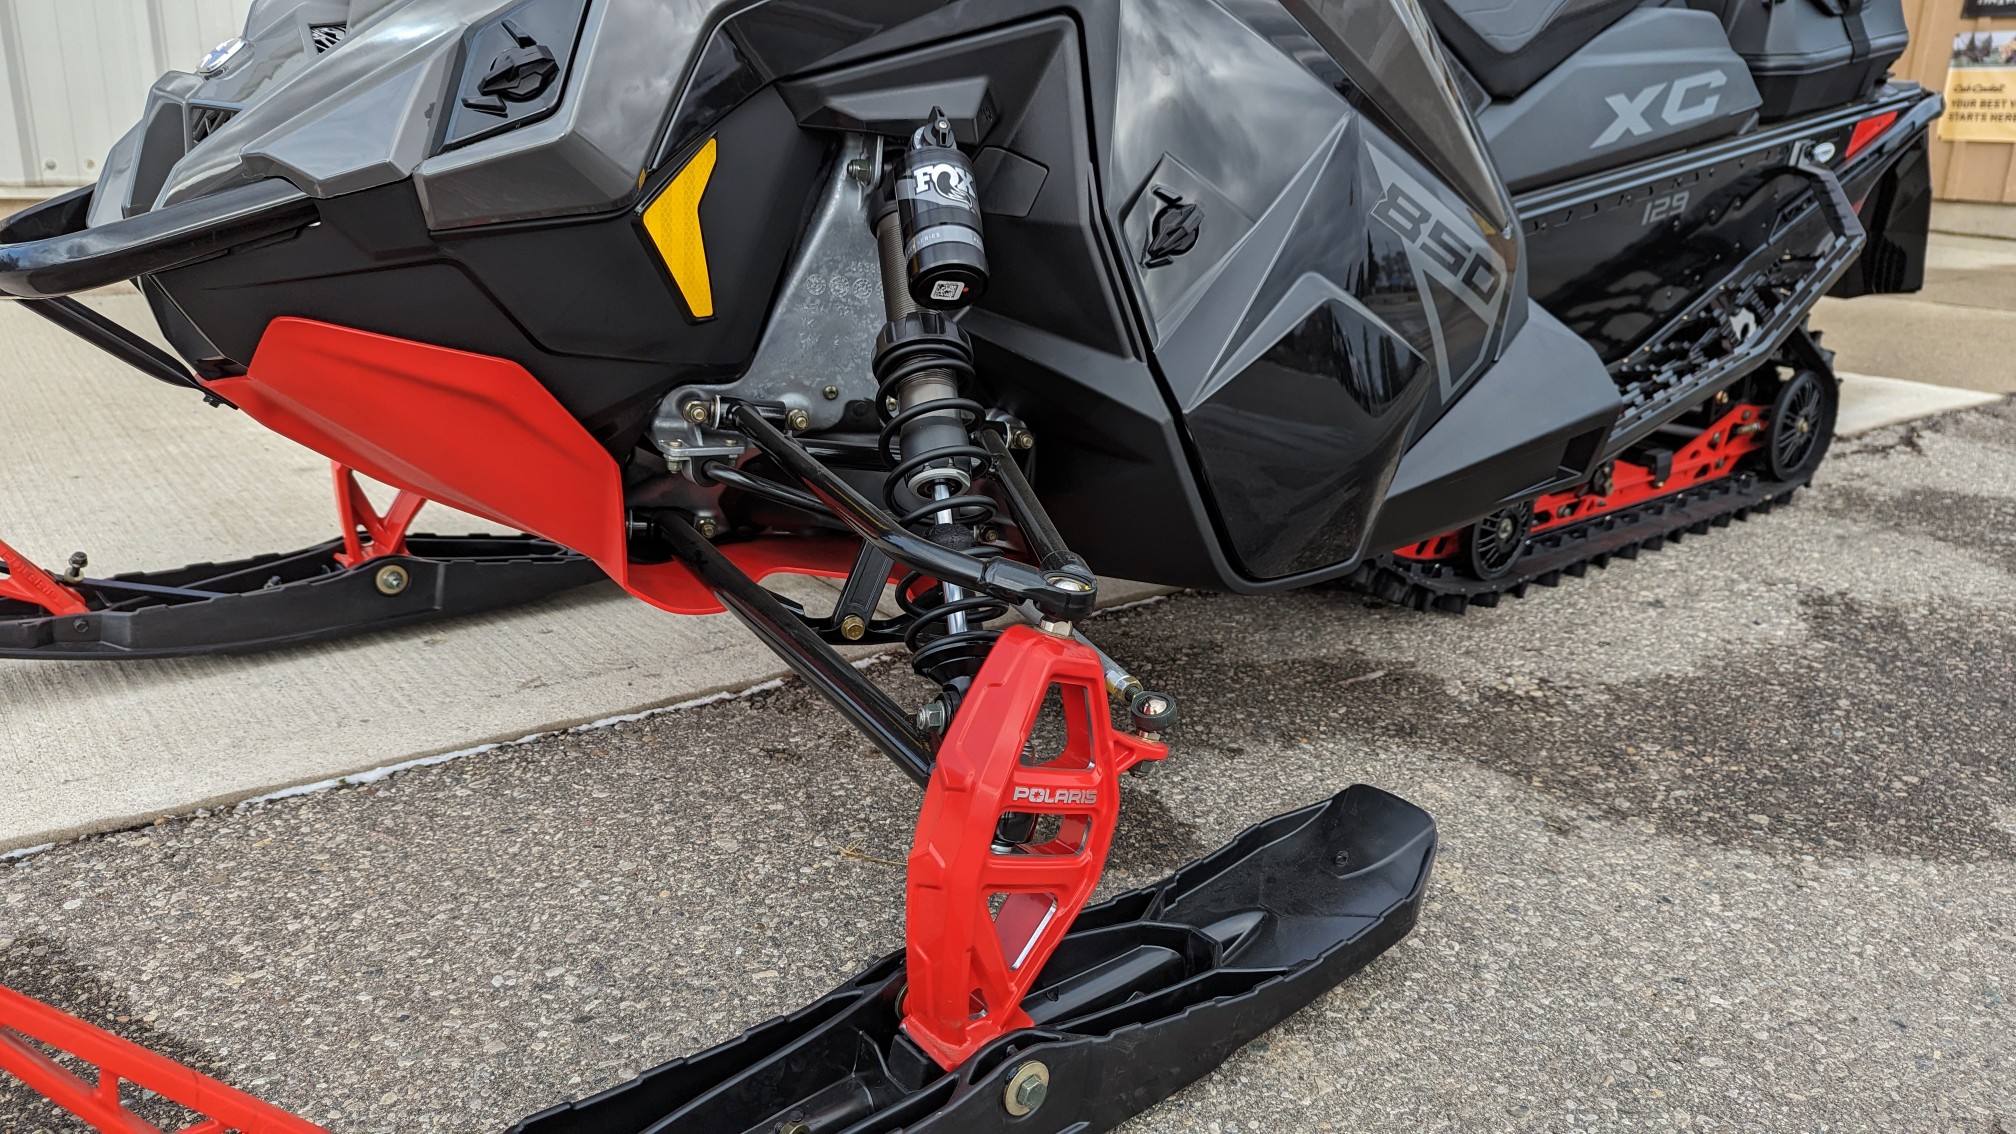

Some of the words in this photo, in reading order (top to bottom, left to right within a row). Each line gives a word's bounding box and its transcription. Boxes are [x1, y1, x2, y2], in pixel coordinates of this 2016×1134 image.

[1589, 69, 1728, 149] XC
[1948, 112, 1988, 122] STARTS
[1952, 99, 1977, 109] YOUR
[1980, 99, 2008, 109] BEST
[913, 163, 977, 208] FOX
[1641, 190, 1690, 226] 129
[1370, 182, 1501, 306] 850
[1012, 786, 1098, 804] POLARIS
